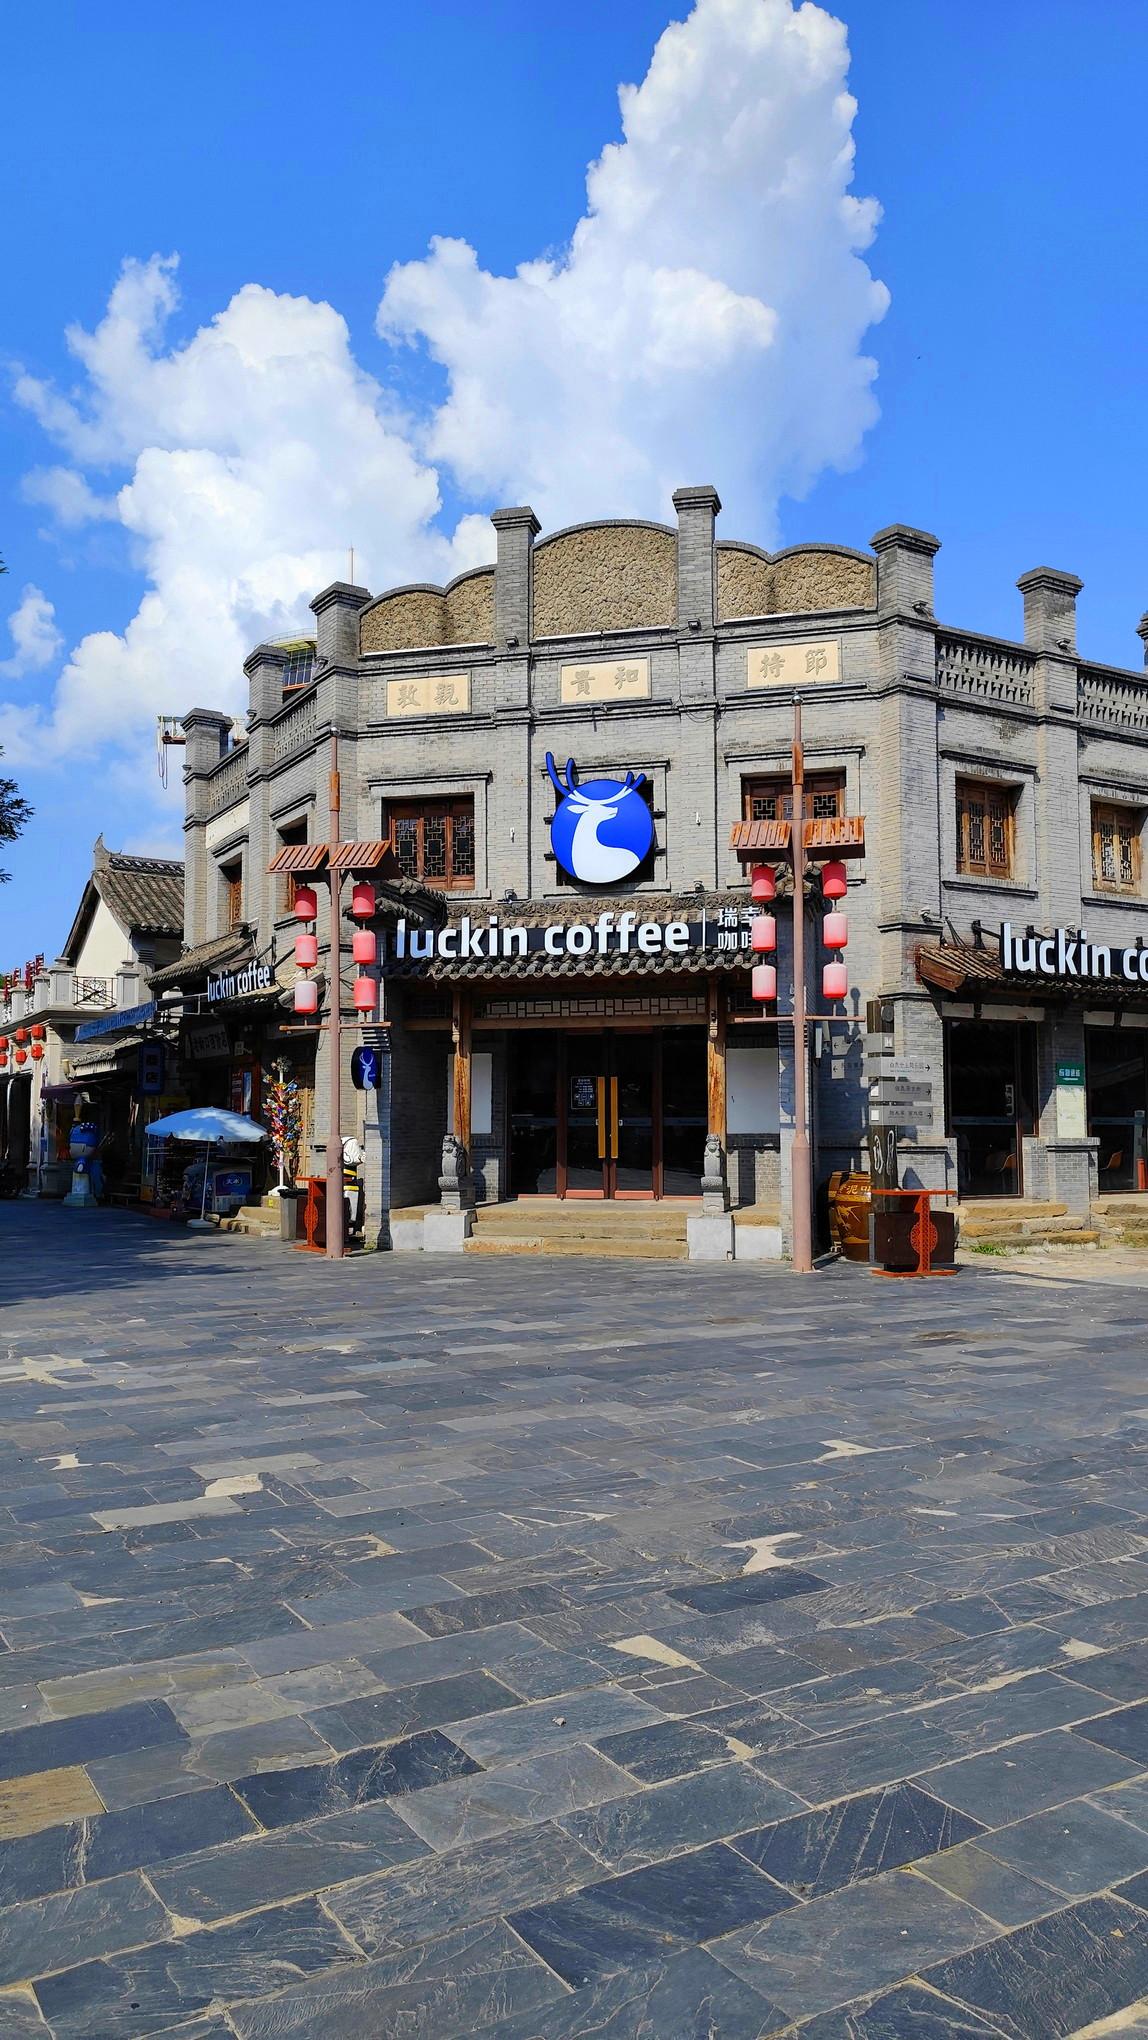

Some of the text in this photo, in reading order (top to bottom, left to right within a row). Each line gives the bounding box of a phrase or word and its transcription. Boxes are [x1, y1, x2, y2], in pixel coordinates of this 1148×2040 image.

[569, 665, 640, 697] 貴和
[395, 911, 691, 959] luckin coffee
[1003, 922, 1112, 978] luckin
[207, 960, 271, 1002] luckin coffee
